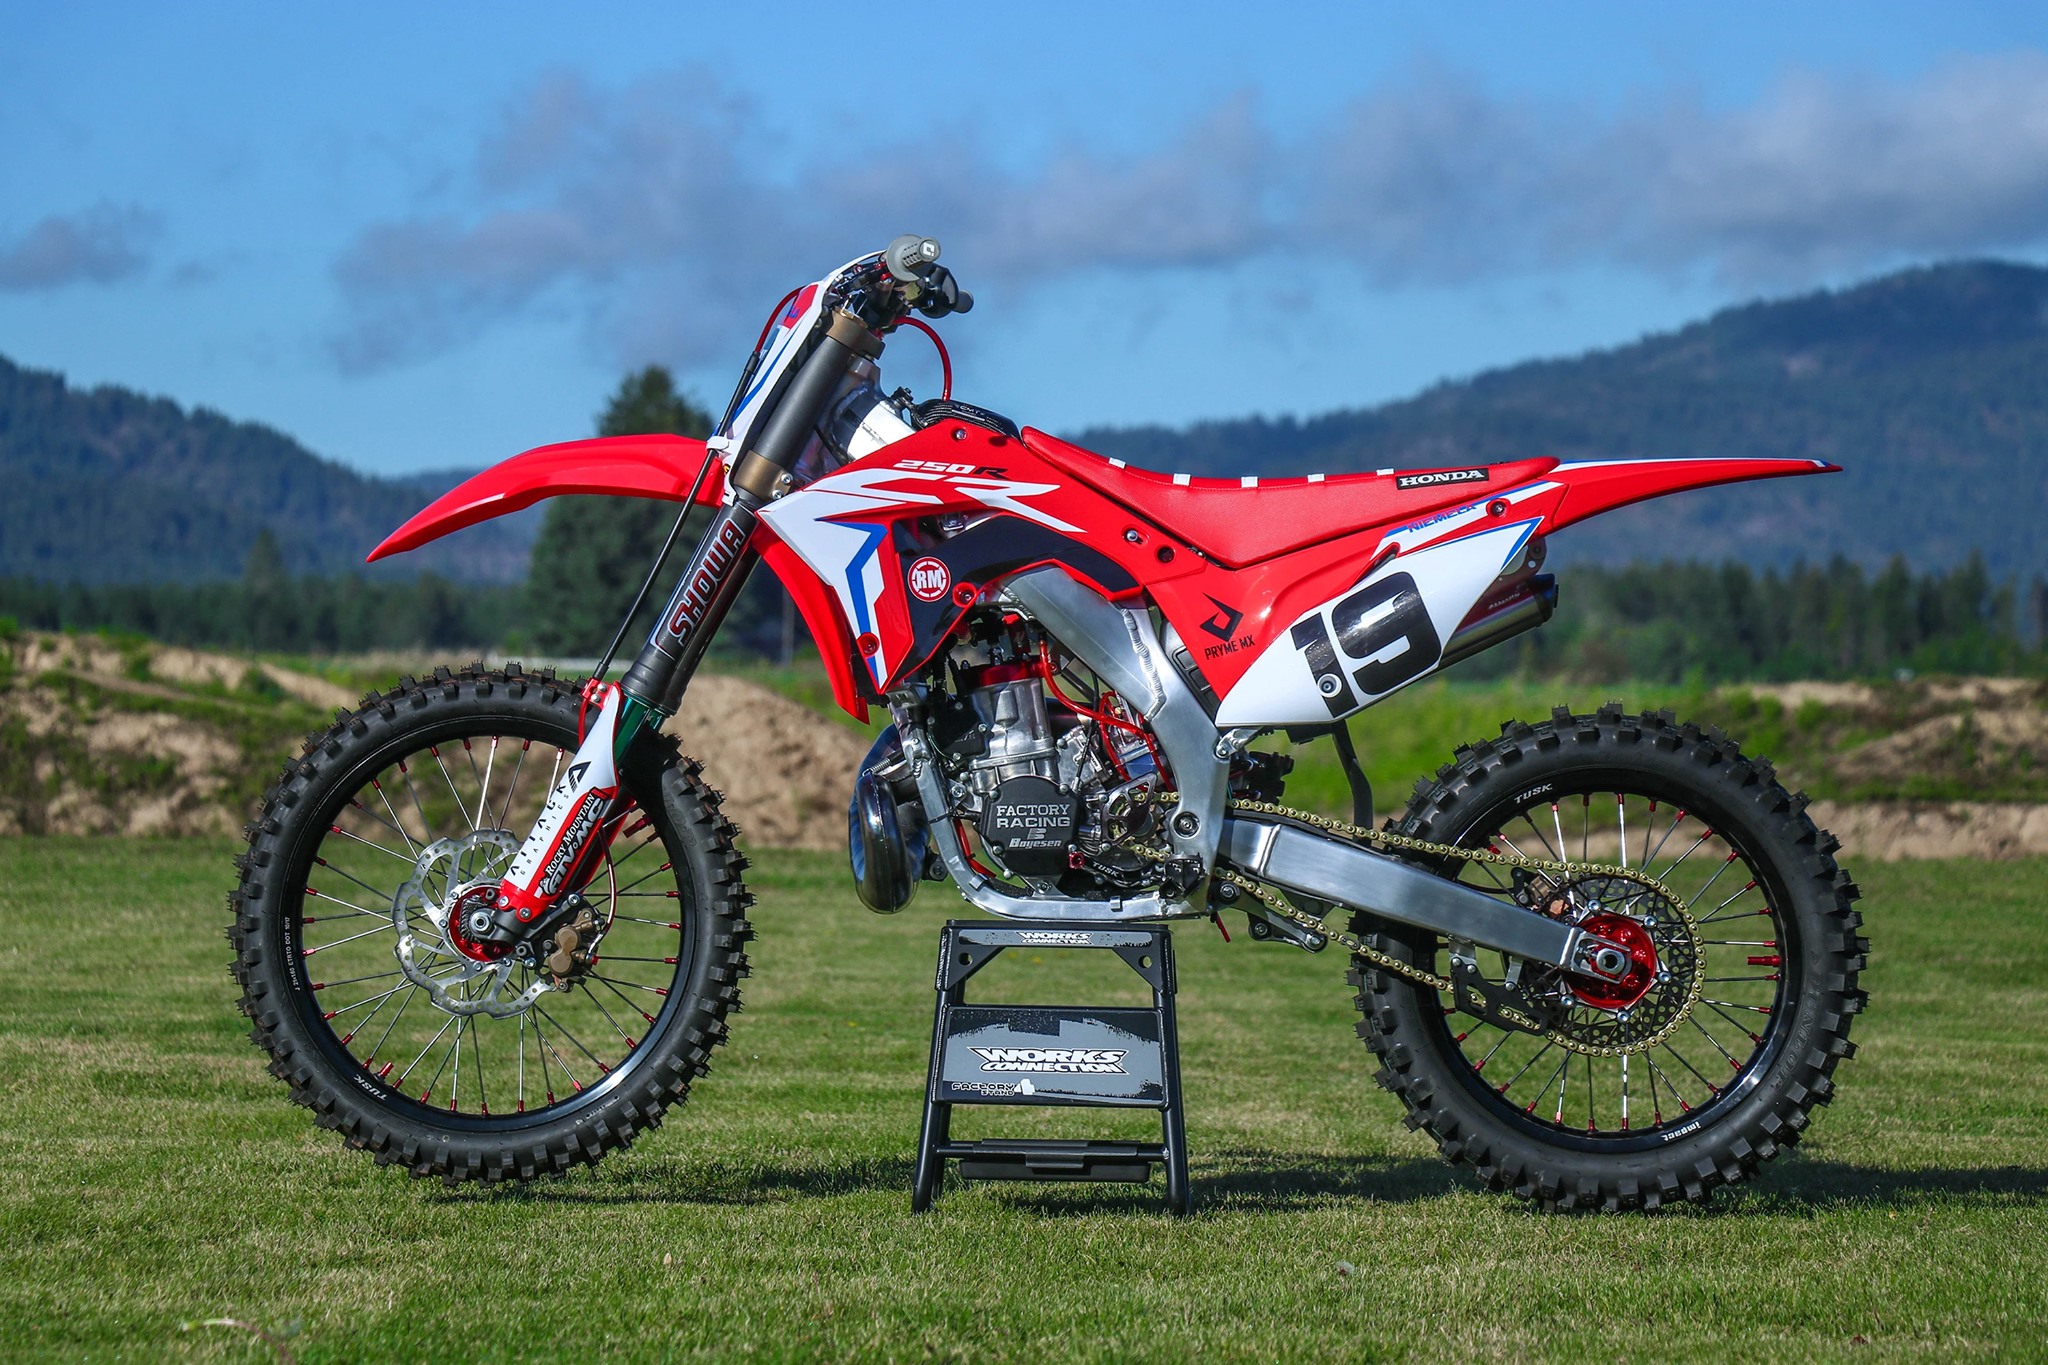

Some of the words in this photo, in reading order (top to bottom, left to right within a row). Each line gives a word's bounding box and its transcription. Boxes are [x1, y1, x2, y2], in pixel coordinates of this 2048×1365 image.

[893, 459, 1008, 481] 250R
[1400, 470, 1485, 487] HONDA
[667, 518, 746, 647] SHOWA
[1204, 640, 1239, 660] PRYME
[1239, 634, 1256, 650] MX
[1290, 571, 1442, 719] 19
[1514, 783, 1553, 804] TUSK
[996, 804, 1070, 817] FACTORY
[996, 817, 1071, 829] RACING
[544, 843, 566, 876] ROCKY
[562, 793, 596, 846] MOUNTAIN
[1009, 837, 1062, 850] Boyesen
[1092, 861, 1121, 877] TUSK
[972, 1049, 1125, 1063] WORKS
[981, 1061, 1128, 1074] CONNECTION
[353, 1073, 387, 1101] TUSK
[1660, 1121, 1701, 1141] impact
